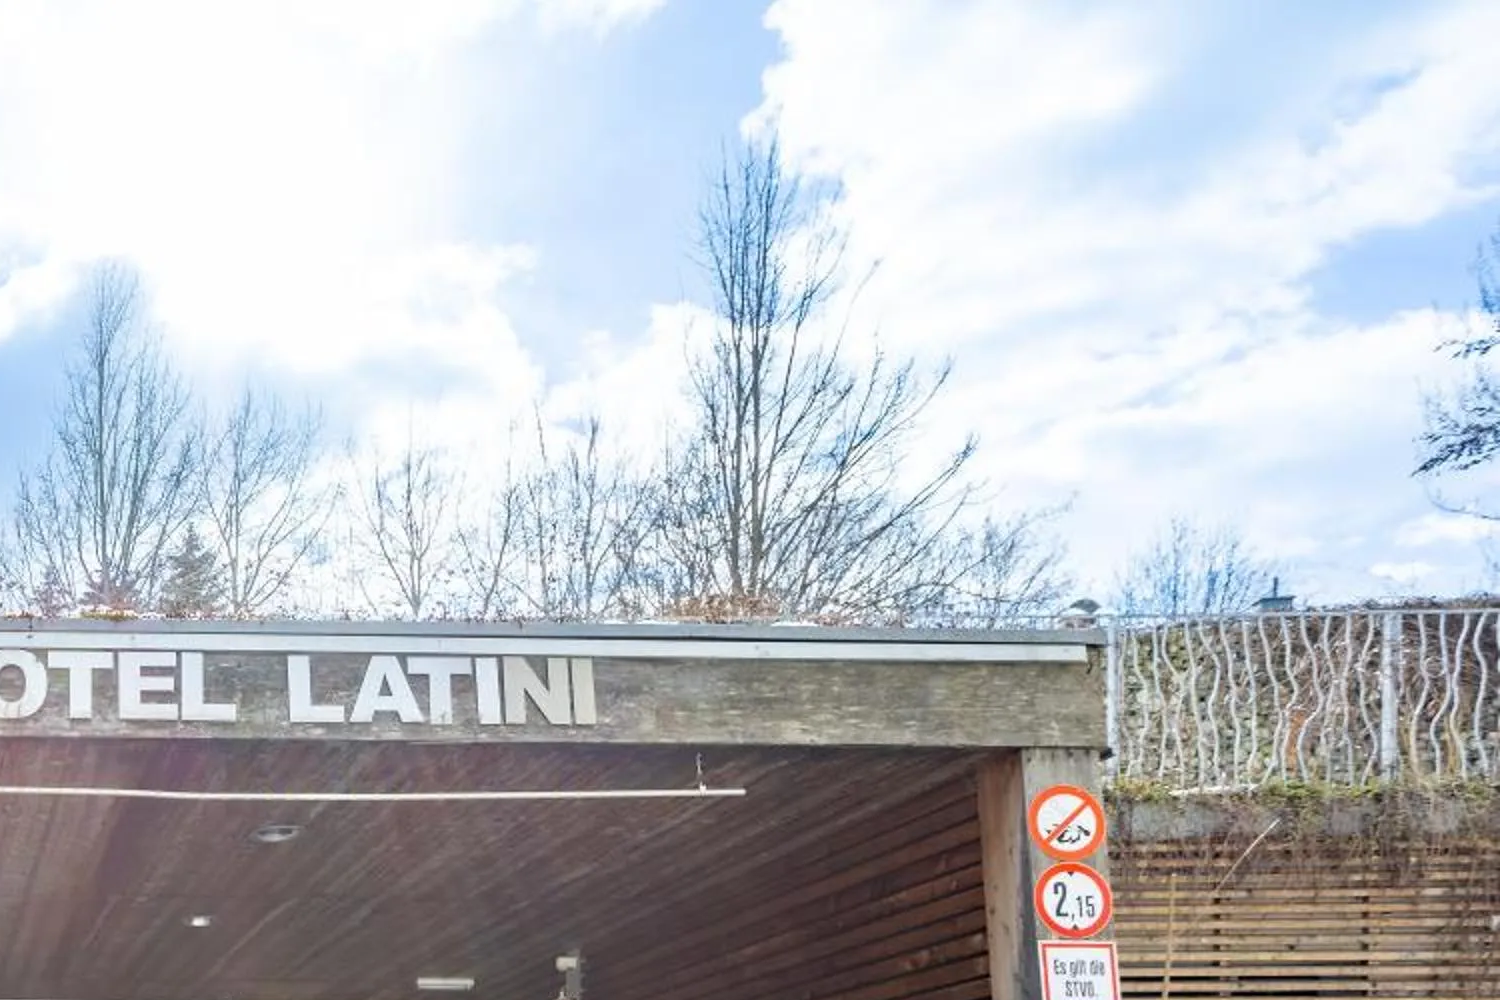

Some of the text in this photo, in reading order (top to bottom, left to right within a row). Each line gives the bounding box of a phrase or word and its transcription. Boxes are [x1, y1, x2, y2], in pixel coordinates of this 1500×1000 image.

[288, 655, 597, 726] LATINI
[1053, 881, 1095, 921] 2,15
[1053, 959, 1067, 975] Es
